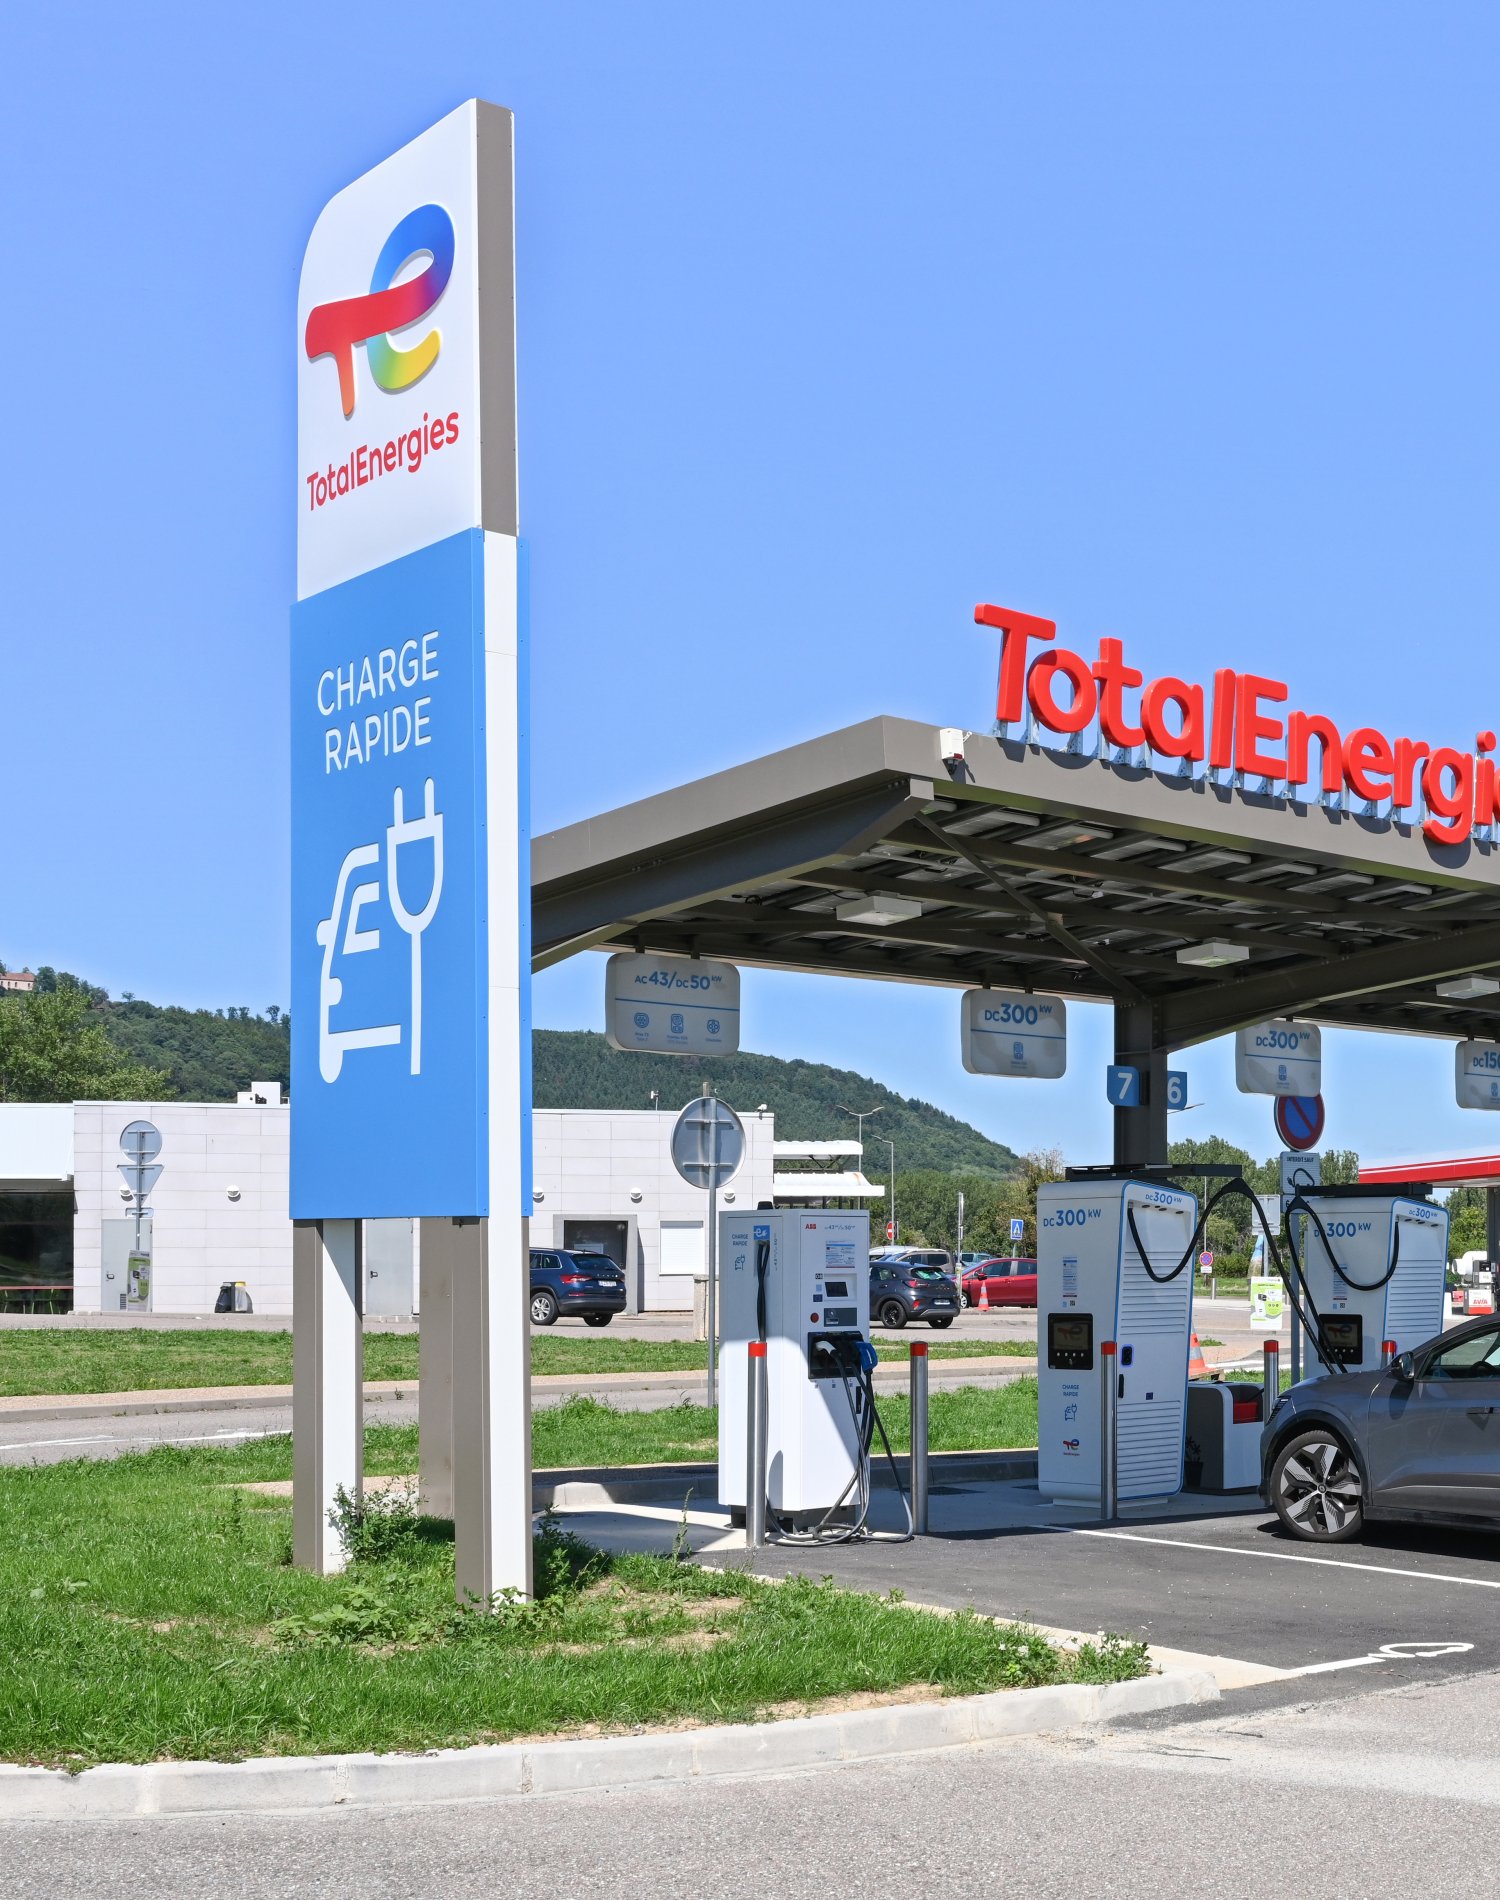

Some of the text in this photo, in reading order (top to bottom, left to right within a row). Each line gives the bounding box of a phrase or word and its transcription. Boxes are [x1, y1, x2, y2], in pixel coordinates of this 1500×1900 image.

[307, 411, 459, 511] TotalEnergies
[317, 630, 439, 716] CHARGE
[326, 696, 431, 774] RAPIDE
[1117, 1072, 1133, 1099] 7
[1167, 1077, 1181, 1104] 6
[1154, 1192, 1173, 1205] 300
[1043, 1209, 1101, 1227] DC 300 kW
[1326, 1222, 1357, 1238] 300
[1358, 1223, 1372, 1232] kW
